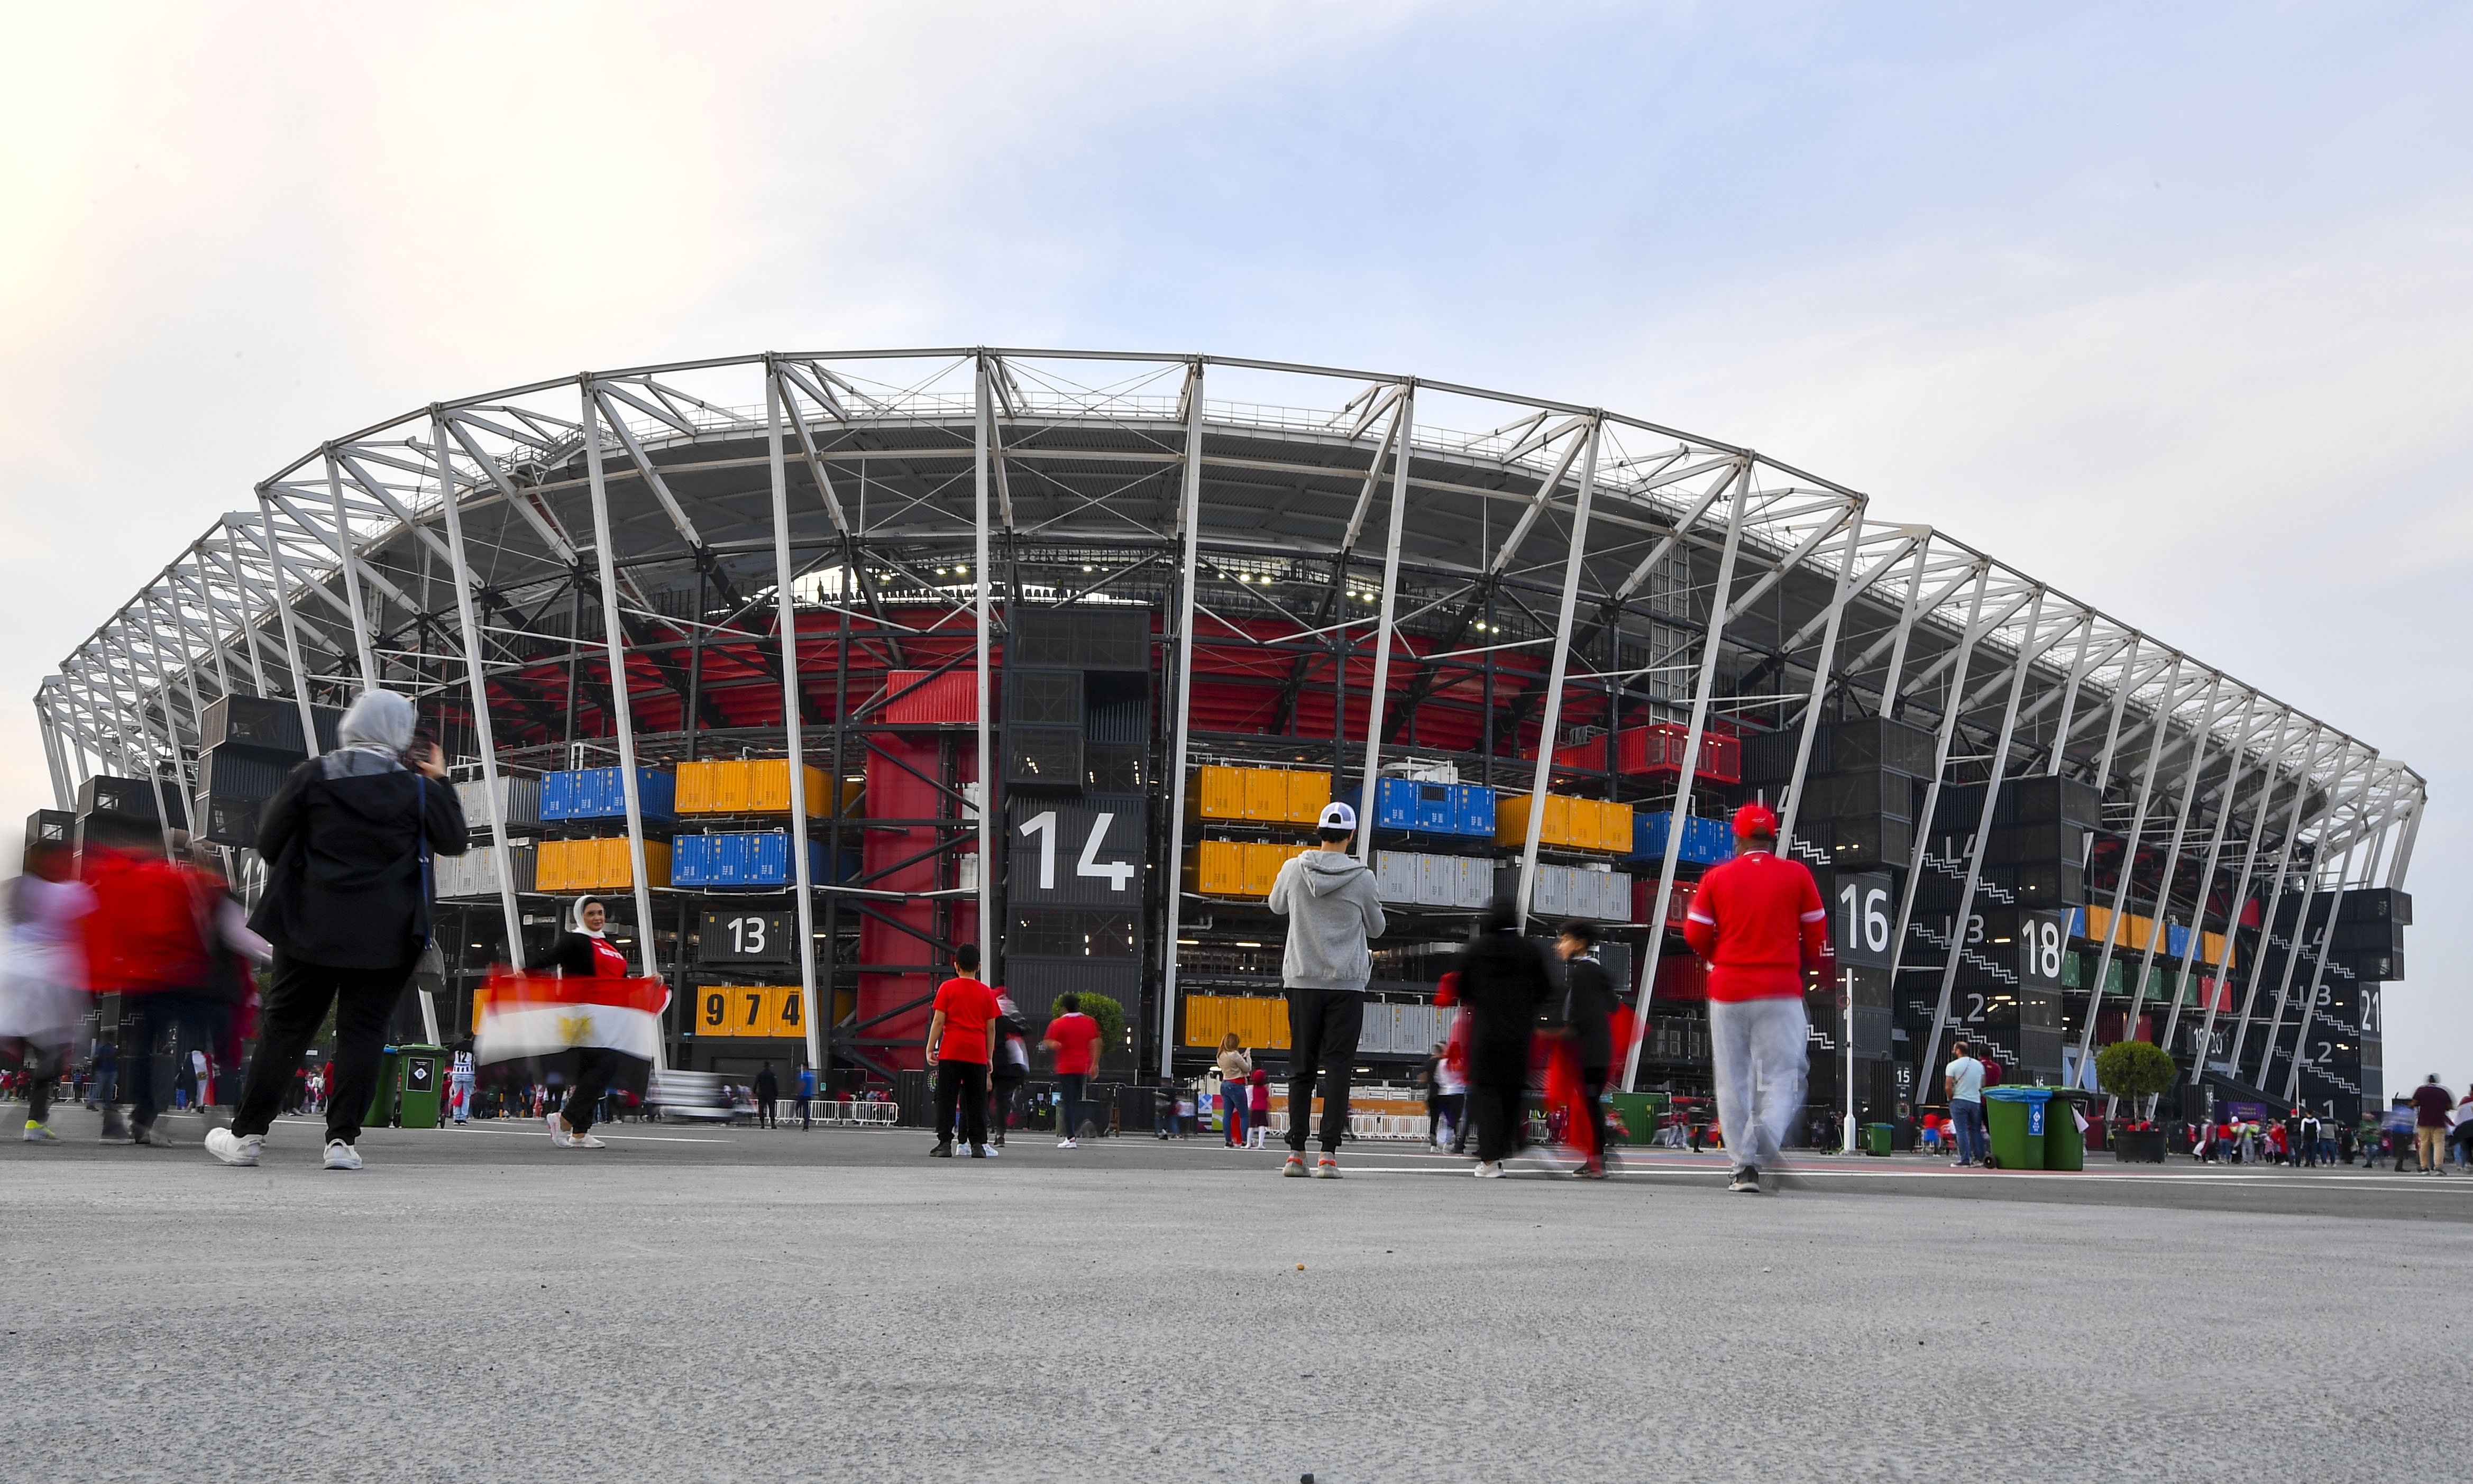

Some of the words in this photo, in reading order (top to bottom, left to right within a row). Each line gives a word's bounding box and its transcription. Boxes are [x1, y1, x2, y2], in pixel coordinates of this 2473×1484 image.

[1019, 811, 1134, 891] 14
[1840, 884, 1888, 952] 16
[1945, 914, 1984, 946] L3
[727, 917, 766, 954] 13
[2022, 919, 2060, 978] 18
[1946, 993, 1985, 1023] L2
[2299, 985, 2331, 1007] L3
[2361, 990, 2380, 1032] 21
[457, 1051, 466, 1063] 12
[2301, 1042, 2333, 1062] L2
[1897, 1070, 1910, 1083] 15
[2206, 1092, 2213, 1103] 18
